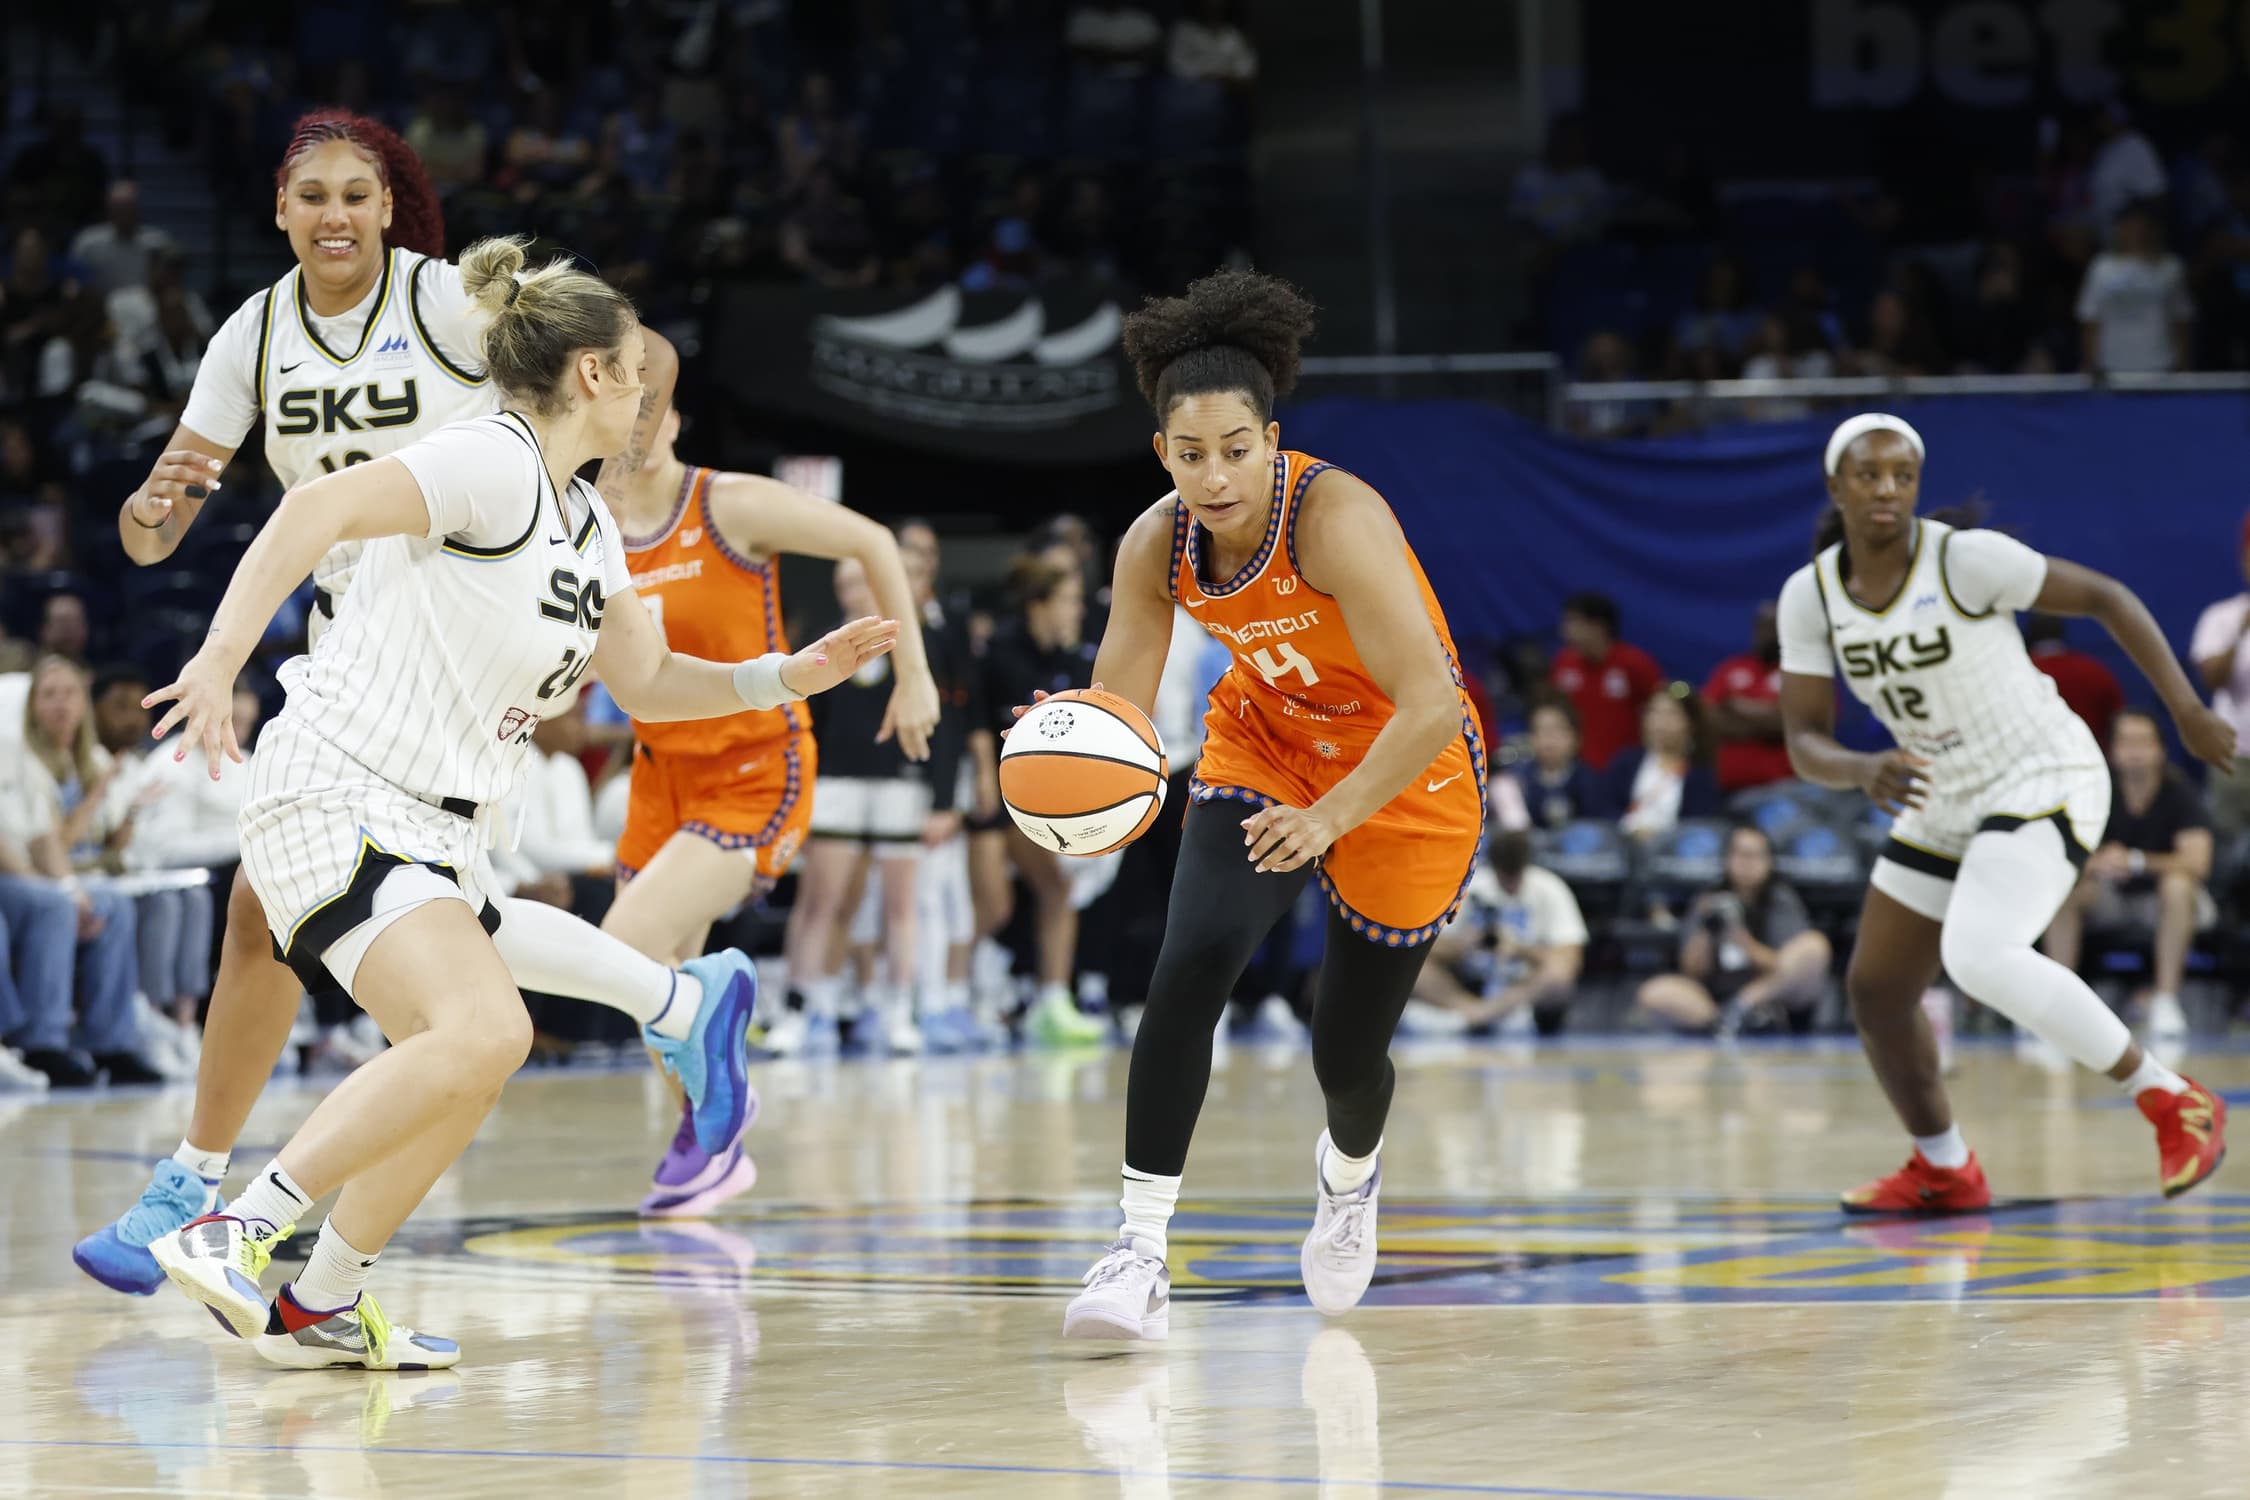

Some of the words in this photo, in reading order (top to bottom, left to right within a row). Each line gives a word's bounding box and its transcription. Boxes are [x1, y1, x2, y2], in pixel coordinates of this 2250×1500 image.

[1811, 0, 2250, 109] bet3
[276, 376, 420, 435] SKY
[536, 647, 593, 701] 24
[1842, 625, 1952, 677] SKY
[1879, 685, 1930, 720] 12
